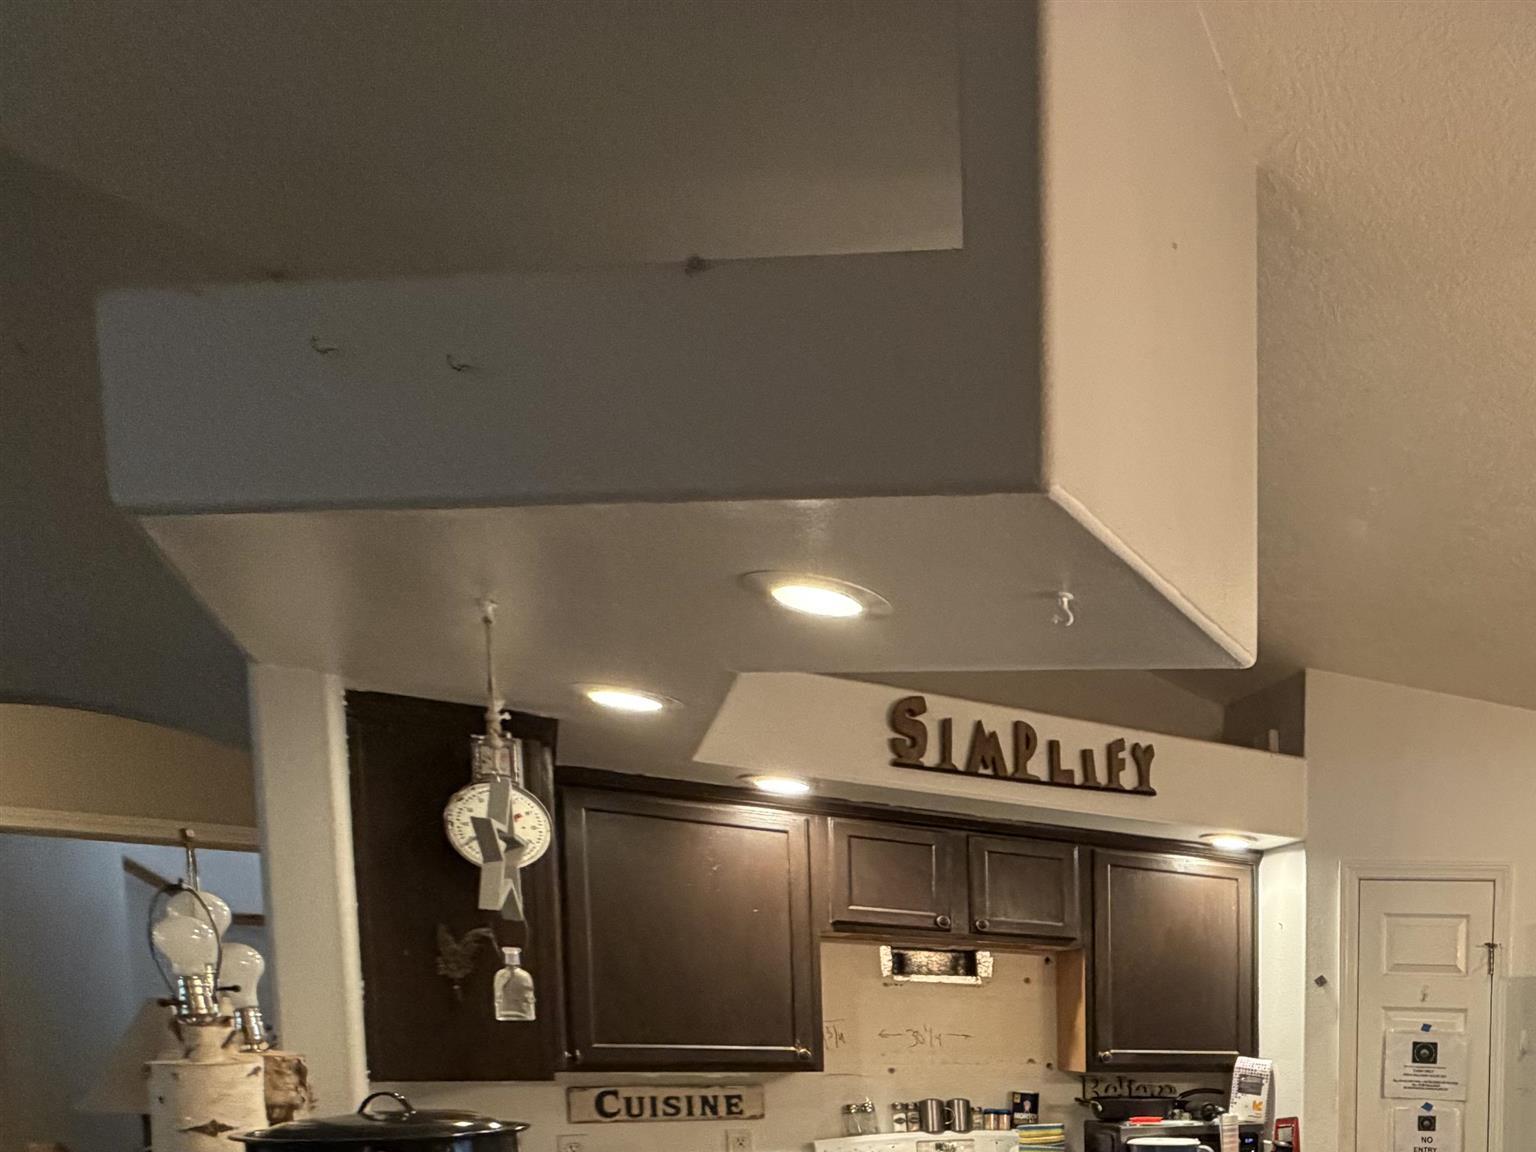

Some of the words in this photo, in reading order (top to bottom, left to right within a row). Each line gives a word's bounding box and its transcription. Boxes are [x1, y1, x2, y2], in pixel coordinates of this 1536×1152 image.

[889, 695, 1156, 792] SIMPLIFY
[595, 1089, 744, 1118] CUISINE
[1420, 1136, 1434, 1144] NO
